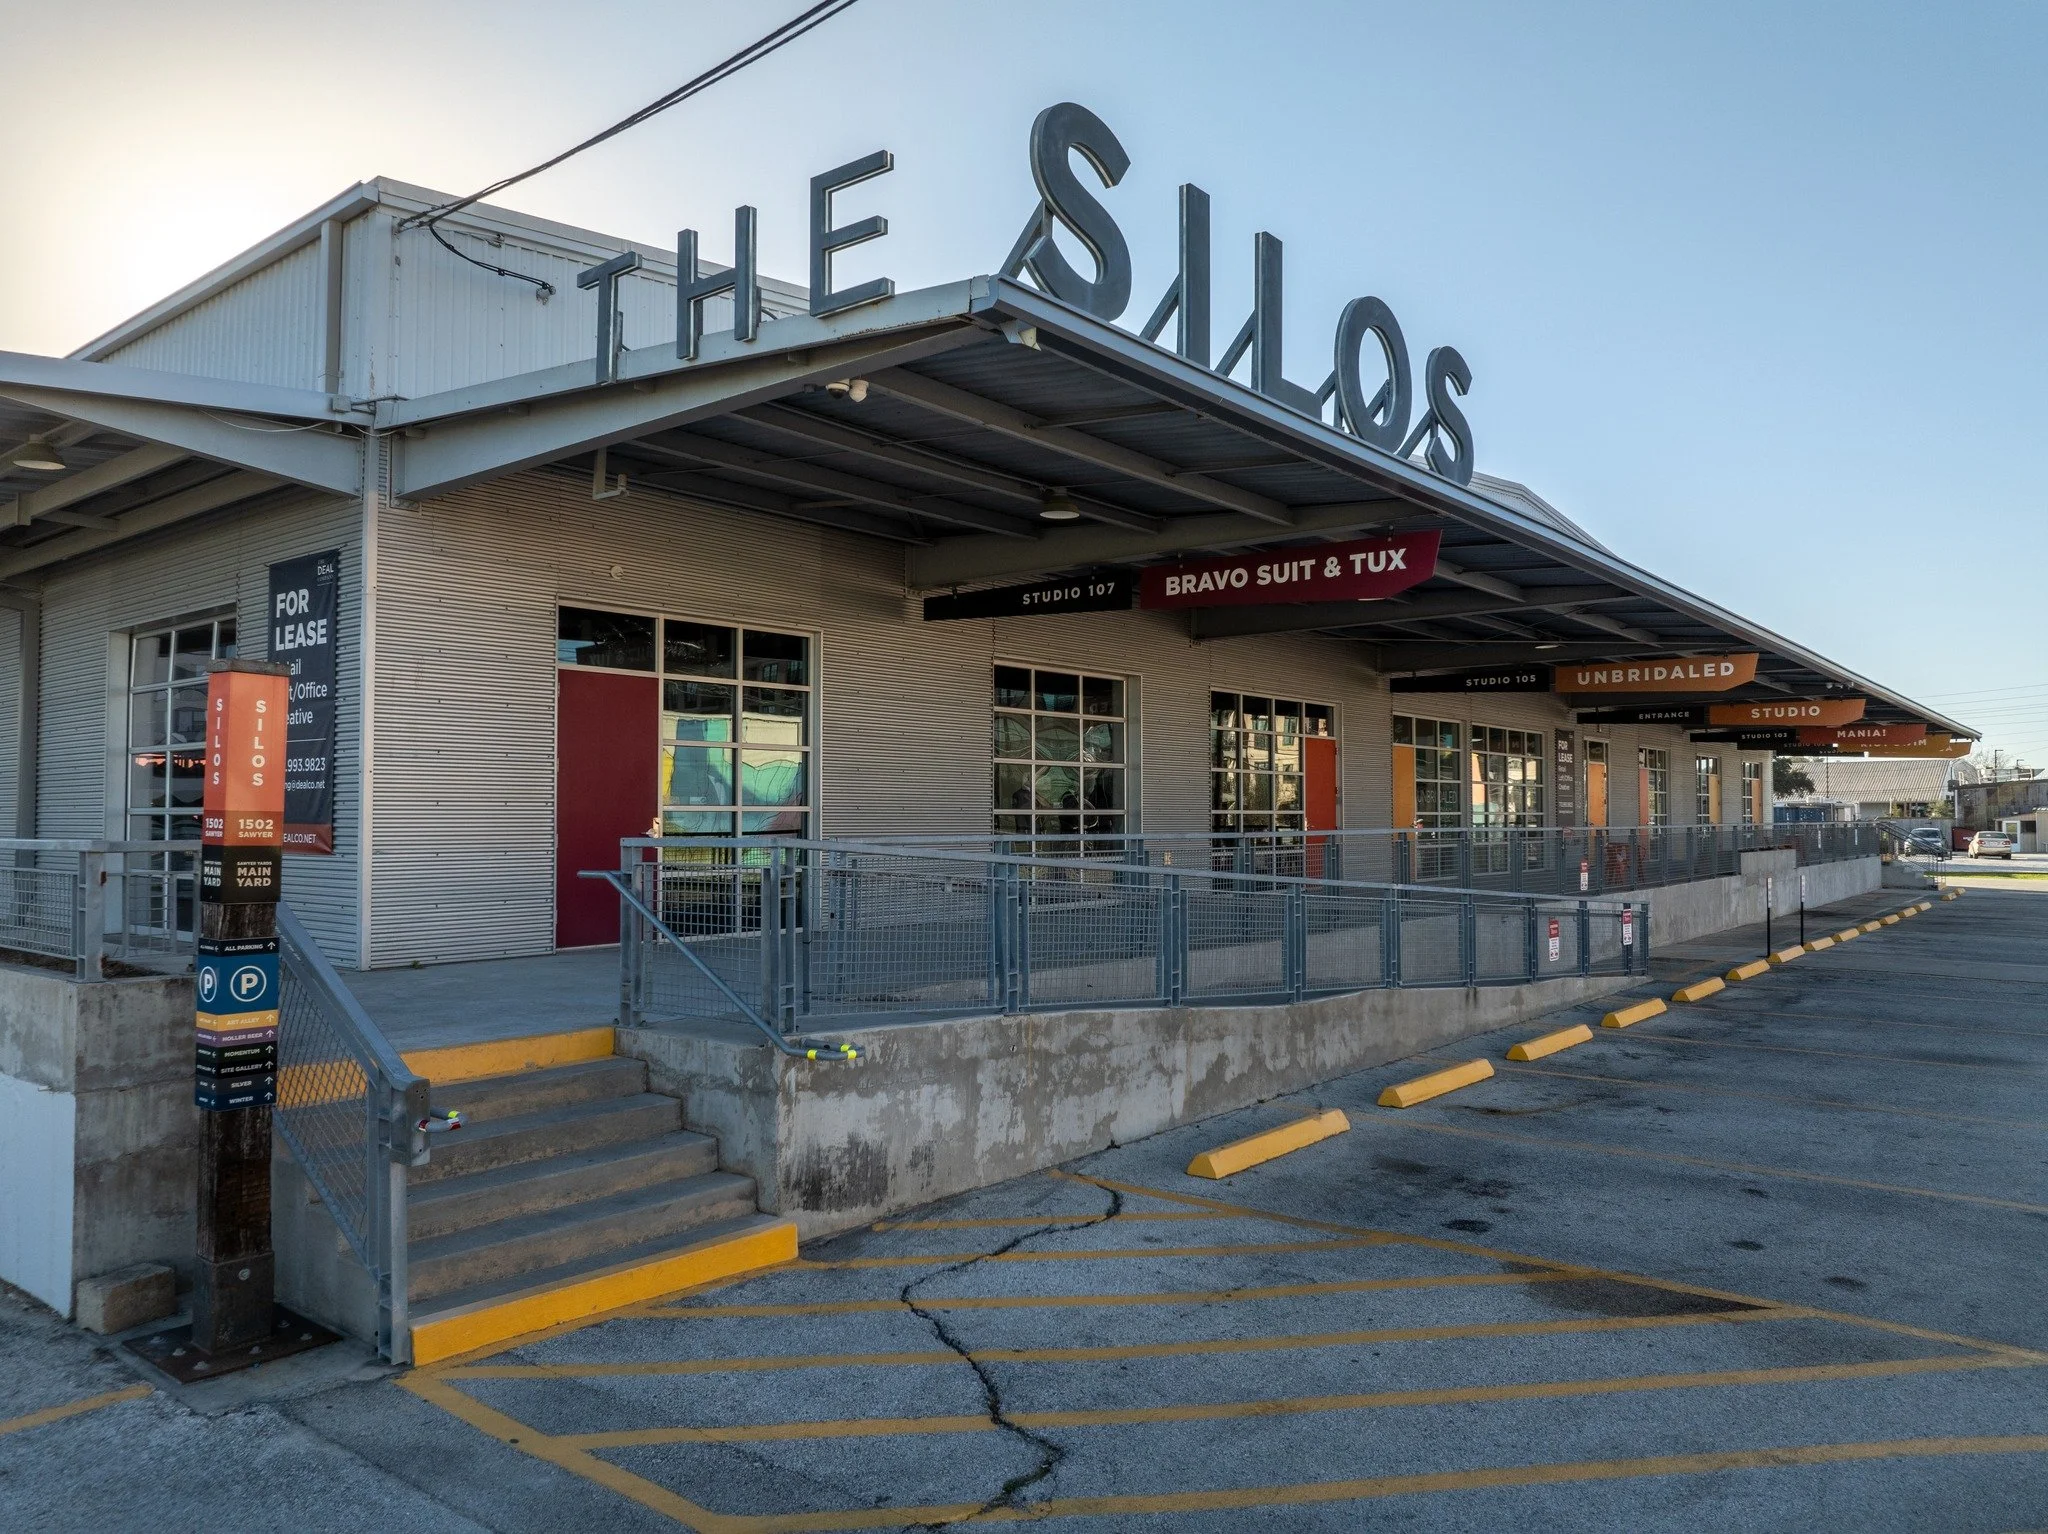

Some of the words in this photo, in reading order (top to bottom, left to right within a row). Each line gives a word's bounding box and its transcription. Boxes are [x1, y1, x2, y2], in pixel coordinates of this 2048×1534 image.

[577, 149, 895, 384] THE
[1020, 102, 1473, 486] SILOS
[317, 564, 334, 576] DEAL
[1165, 567, 1249, 596] BRAVO
[1256, 559, 1316, 586] SUIT
[1323, 556, 1342, 578] &
[1349, 548, 1407, 575] TUX
[1022, 586, 1081, 605] STUDIO
[1088, 582, 1115, 597] 107
[276, 588, 309, 618] FOR
[275, 618, 328, 652] LEASE
[1577, 662, 1735, 685] UNBRIDALED
[1465, 676, 1511, 687] STUDIO
[1515, 674, 1536, 684] 105
[289, 682, 328, 702] t/Office
[1638, 710, 1690, 720] ENTRANCE
[1751, 705, 1821, 719] STUDIO
[1836, 729, 1887, 738] MANIA!
[213, 698, 223, 786] SILOS
[251, 699, 267, 787] SILOS
[1558, 740, 1568, 750] FOR
[1558, 752, 1573, 763] LEASE
[285, 757, 326, 772] .993.9823
[284, 779, 326, 791] ng@dealco.net
[205, 818, 224, 829] 1502
[238, 819, 274, 830] 1502
[205, 830, 224, 838] SAWYER
[283, 833, 317, 843] EALCO.NET
[204, 866, 222, 876] MAIN
[237, 867, 272, 877] MAIN
[203, 876, 222, 887] YARD
[236, 877, 272, 887] YARD
[204, 973, 213, 995] P
[241, 973, 259, 995] P
[224, 1048, 261, 1057] MOMENTUM
[221, 1066, 235, 1074] SITE
[235, 1063, 263, 1072] GALLERY
[231, 1080, 252, 1088] SILVER
[229, 1095, 254, 1104] WINTER
